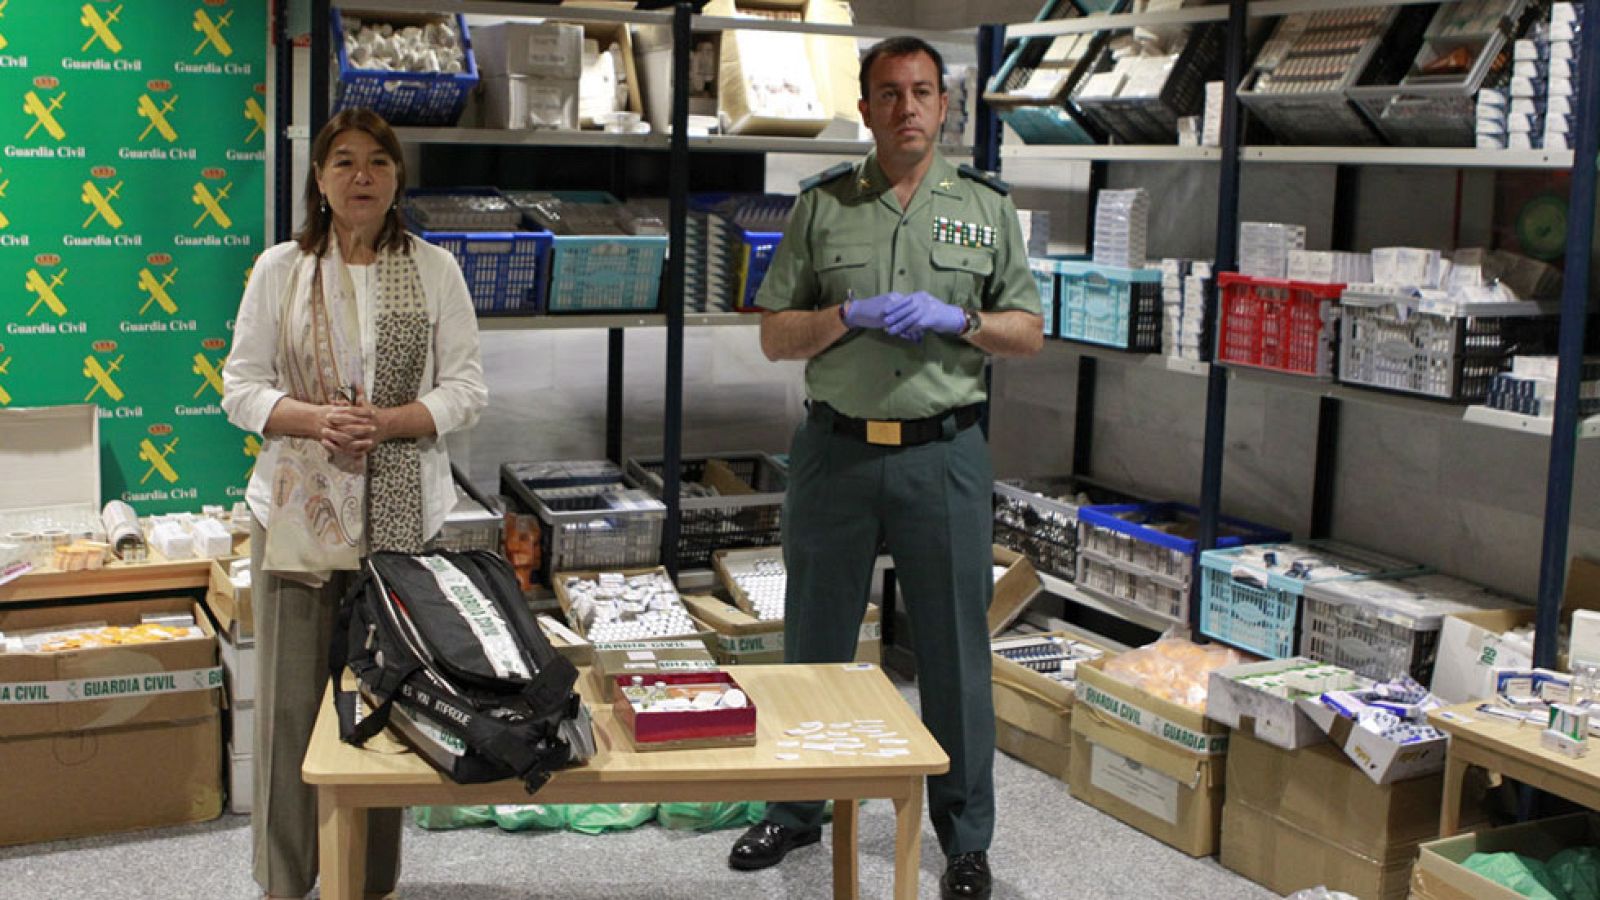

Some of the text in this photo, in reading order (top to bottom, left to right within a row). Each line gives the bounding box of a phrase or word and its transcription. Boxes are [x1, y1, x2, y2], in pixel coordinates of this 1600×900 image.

[62, 57, 142, 71] Guardia Civil
[174, 61, 251, 75] Guardia Civil
[4, 145, 85, 158] Guardia Civil
[118, 148, 196, 160] Guardia Civil
[0, 234, 29, 246] Civil
[63, 235, 142, 246] Guardia Civil
[174, 235, 250, 246] Guardia Civil
[7, 323, 87, 334] Guardia Civil
[120, 320, 196, 332] Guardia Civil
[115, 406, 143, 418] Civil
[175, 404, 221, 415] Guardia
[122, 489, 198, 501] Guardia Civil
[84, 675, 176, 697] GUARDIA CIVIL
[15, 685, 50, 700] CIVIL
[1085, 687, 1141, 725] GUARDIA CIVIL
[1163, 722, 1206, 749] GUARDIA
